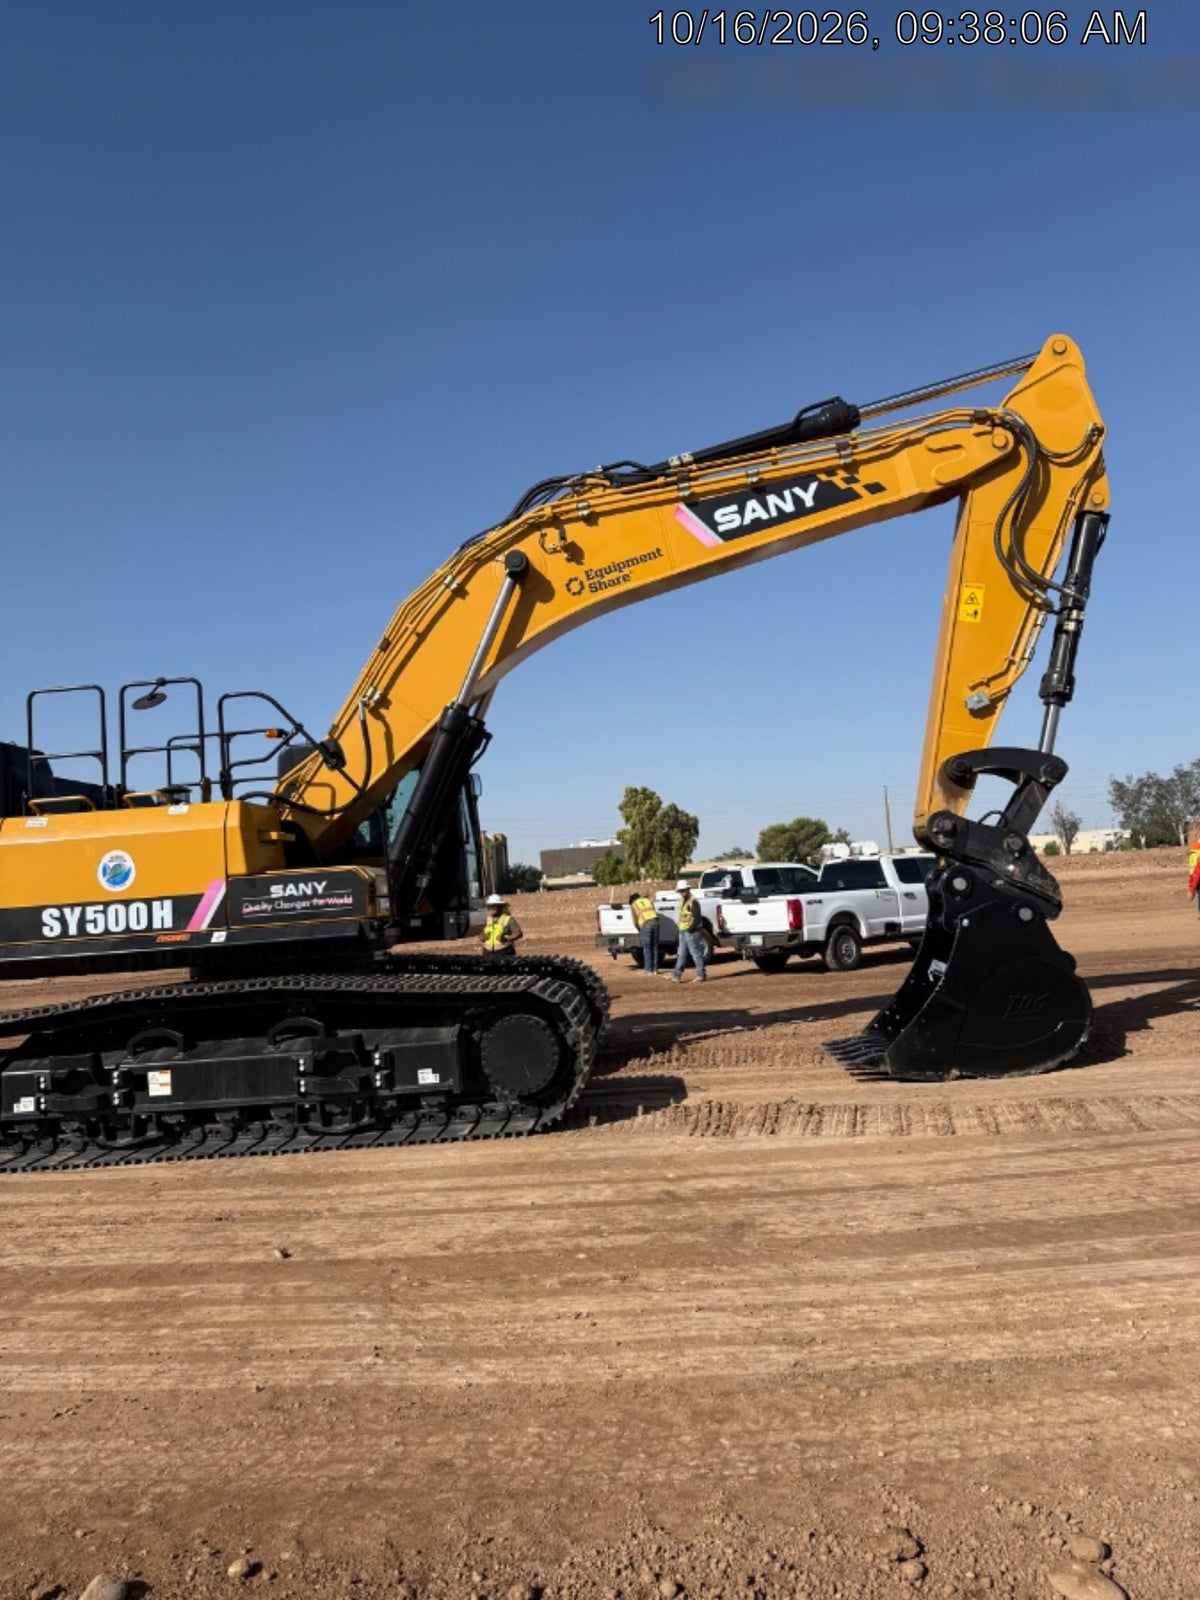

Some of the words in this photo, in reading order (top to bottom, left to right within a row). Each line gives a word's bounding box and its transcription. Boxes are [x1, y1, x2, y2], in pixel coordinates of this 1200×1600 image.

[713, 481, 819, 532] SANY
[584, 547, 664, 581] Equipment
[588, 573, 632, 593] Share
[269, 880, 328, 899] SANY
[41, 899, 173, 938] SY500H
